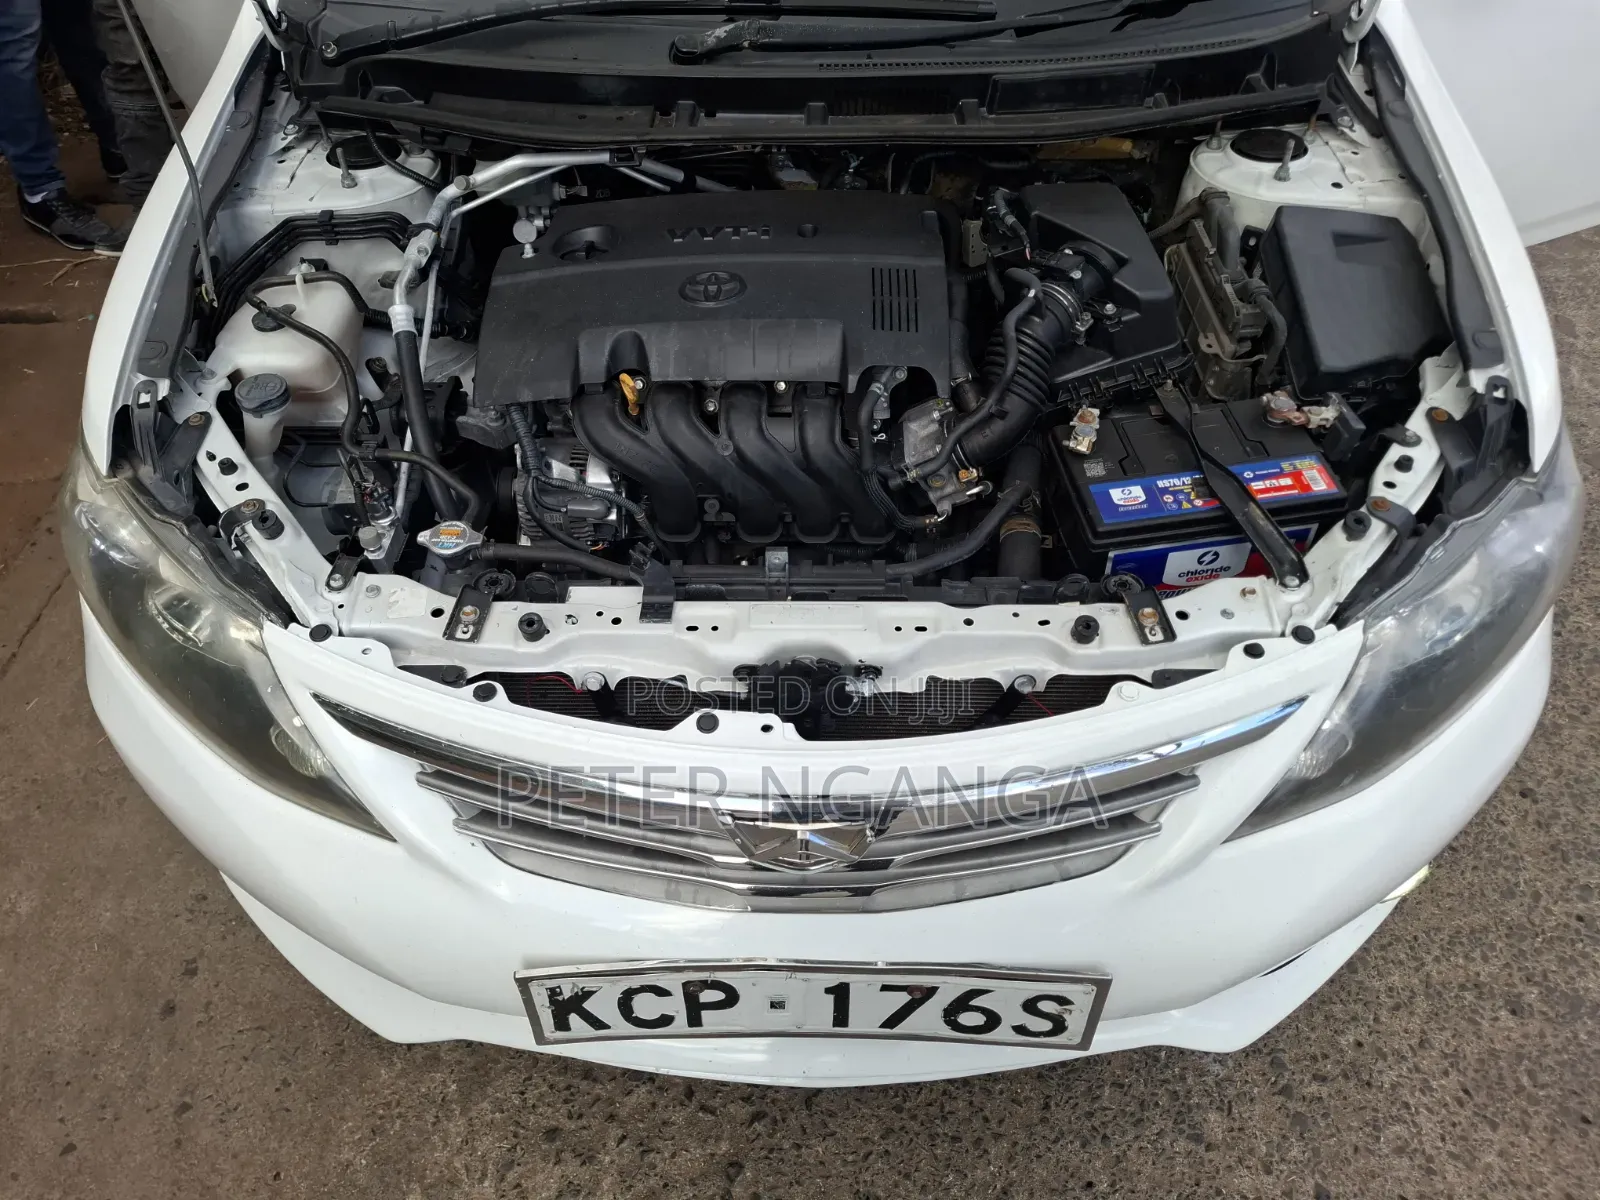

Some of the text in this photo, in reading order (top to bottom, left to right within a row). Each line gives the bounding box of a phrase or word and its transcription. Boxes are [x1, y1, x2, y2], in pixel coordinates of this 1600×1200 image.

[1178, 566, 1231, 578] chloride
[1186, 574, 1221, 582] exide
[547, 980, 1076, 1038] KCP 176S
